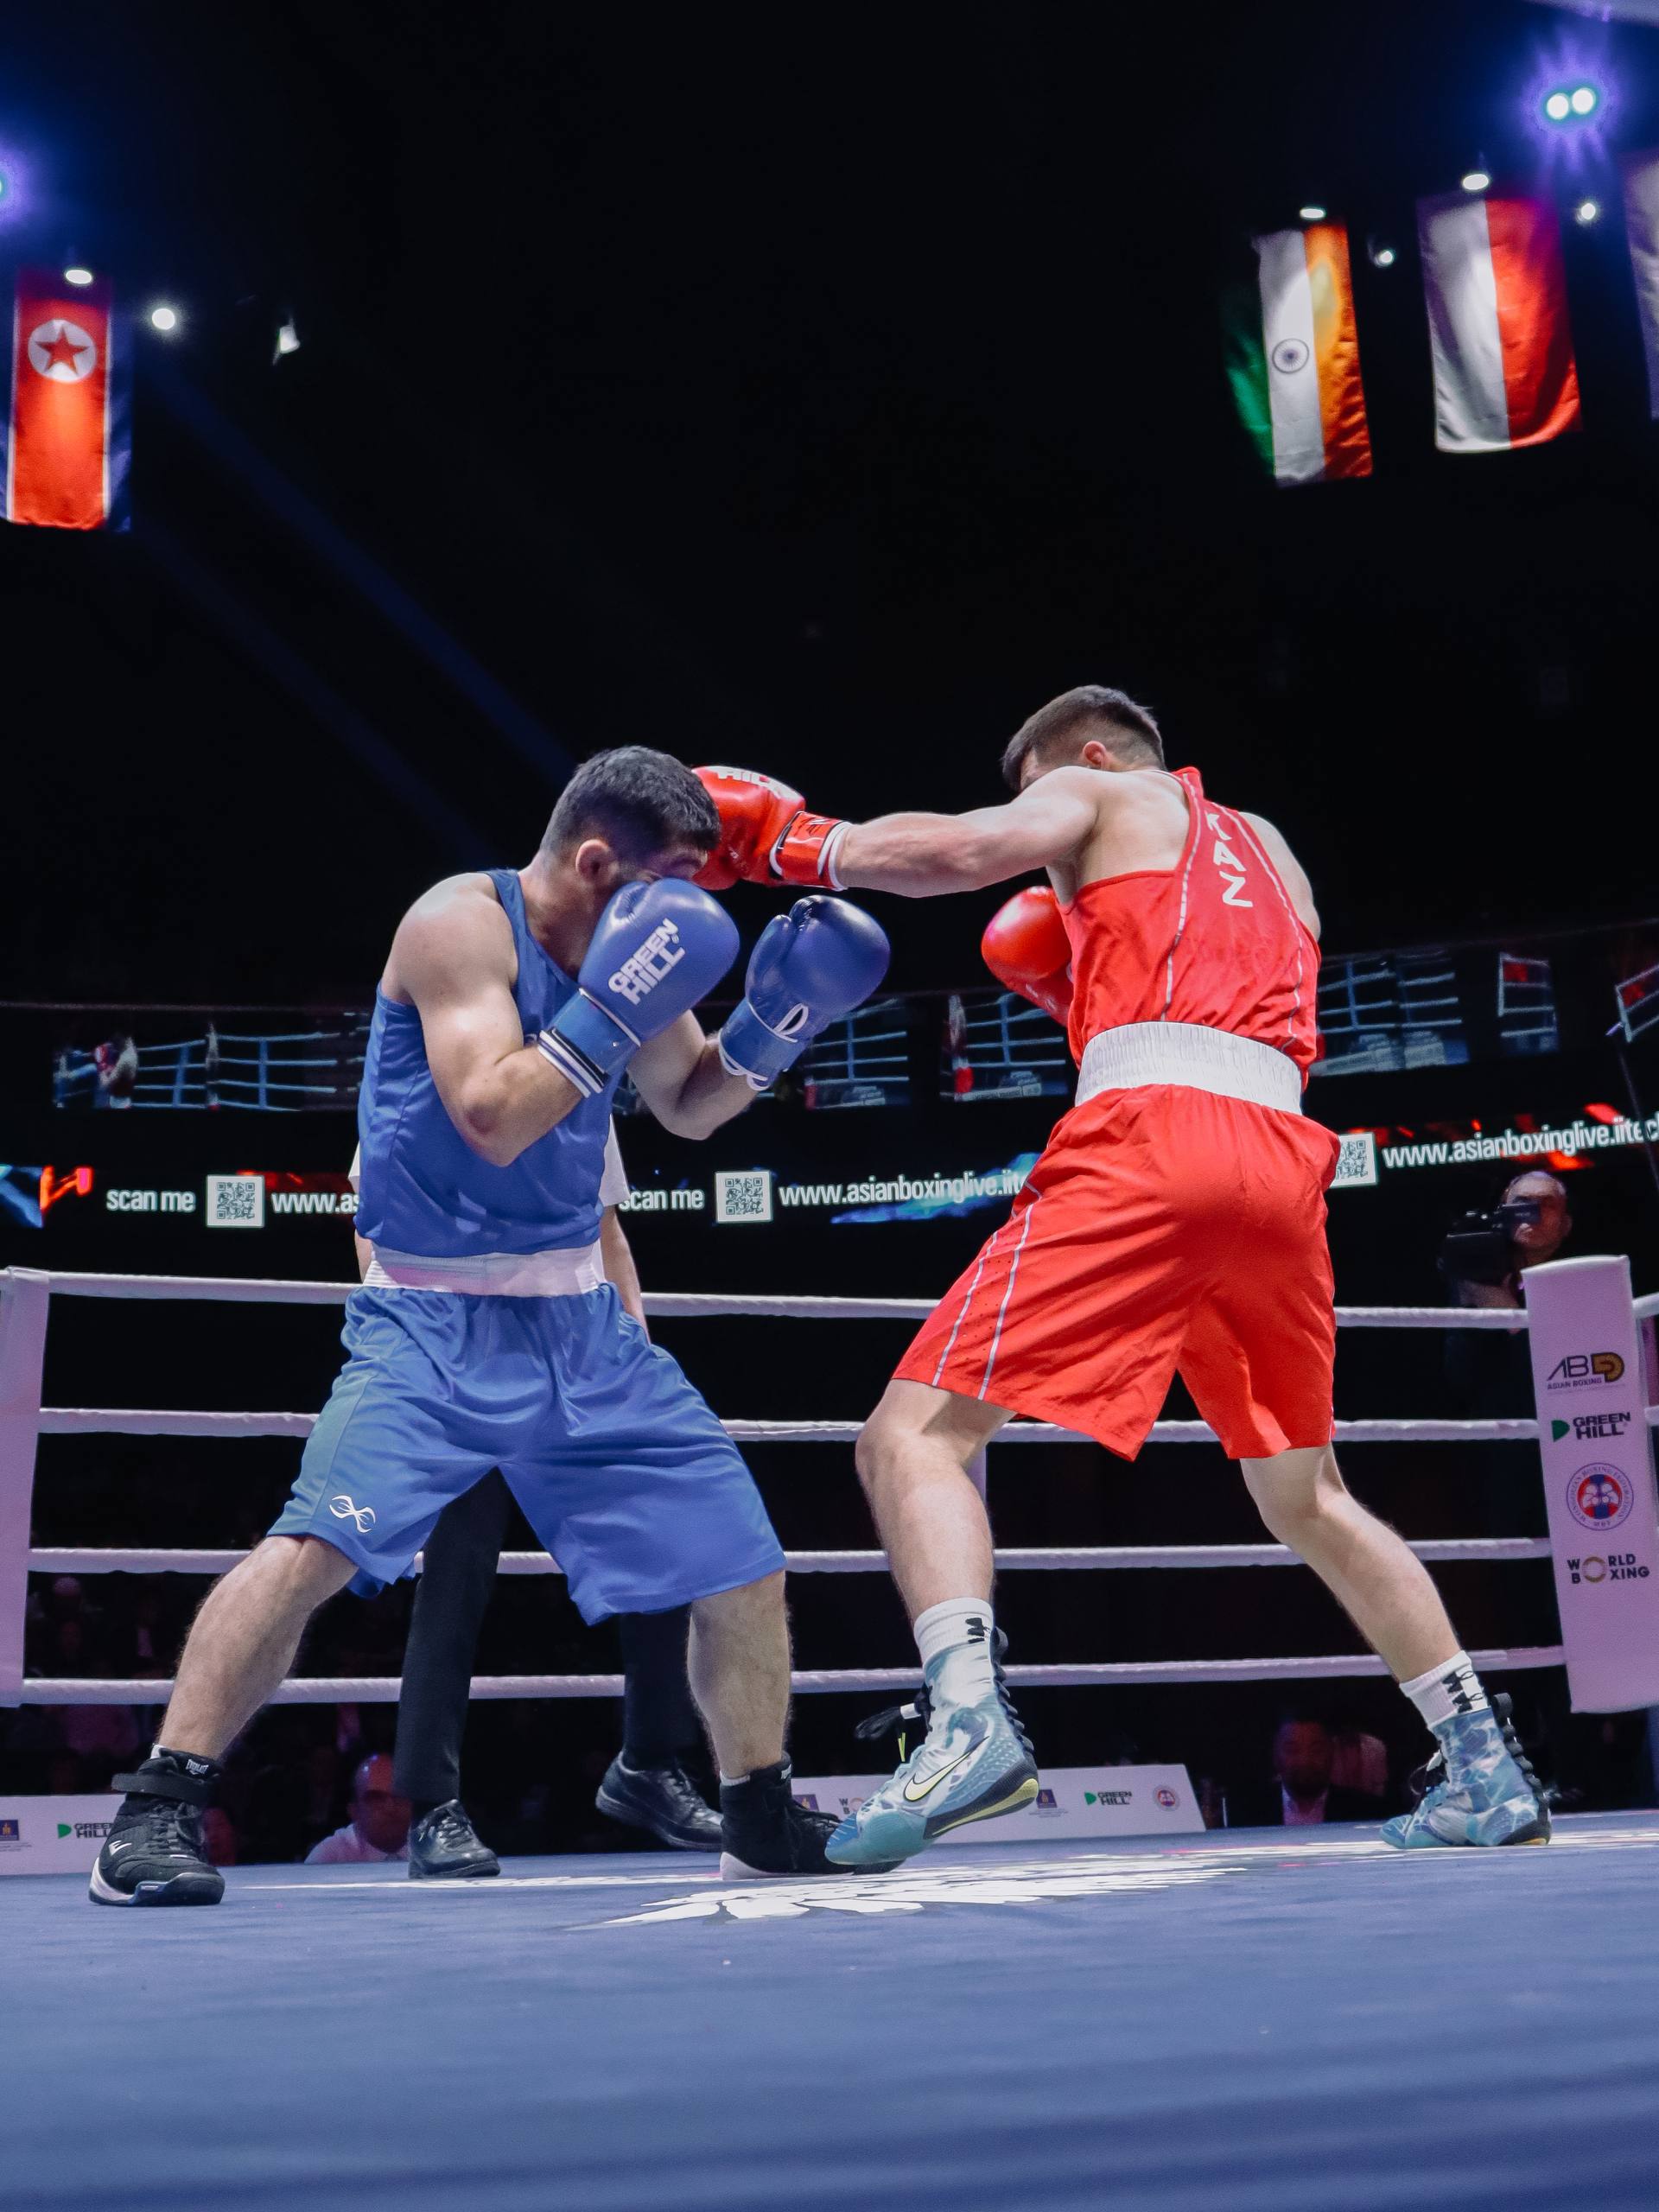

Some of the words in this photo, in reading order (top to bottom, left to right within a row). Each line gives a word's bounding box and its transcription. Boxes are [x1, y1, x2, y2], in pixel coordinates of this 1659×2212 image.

[608, 918, 678, 994] GREEN
[622, 946, 686, 1005] HILL
[106, 1189, 157, 1211] scan
[161, 1191, 196, 1211] me
[671, 1189, 705, 1209] me
[1573, 1411, 1630, 1427] GREEN
[1576, 1423, 1624, 1440] HILL
[1101, 1796, 1130, 1805] HILL
